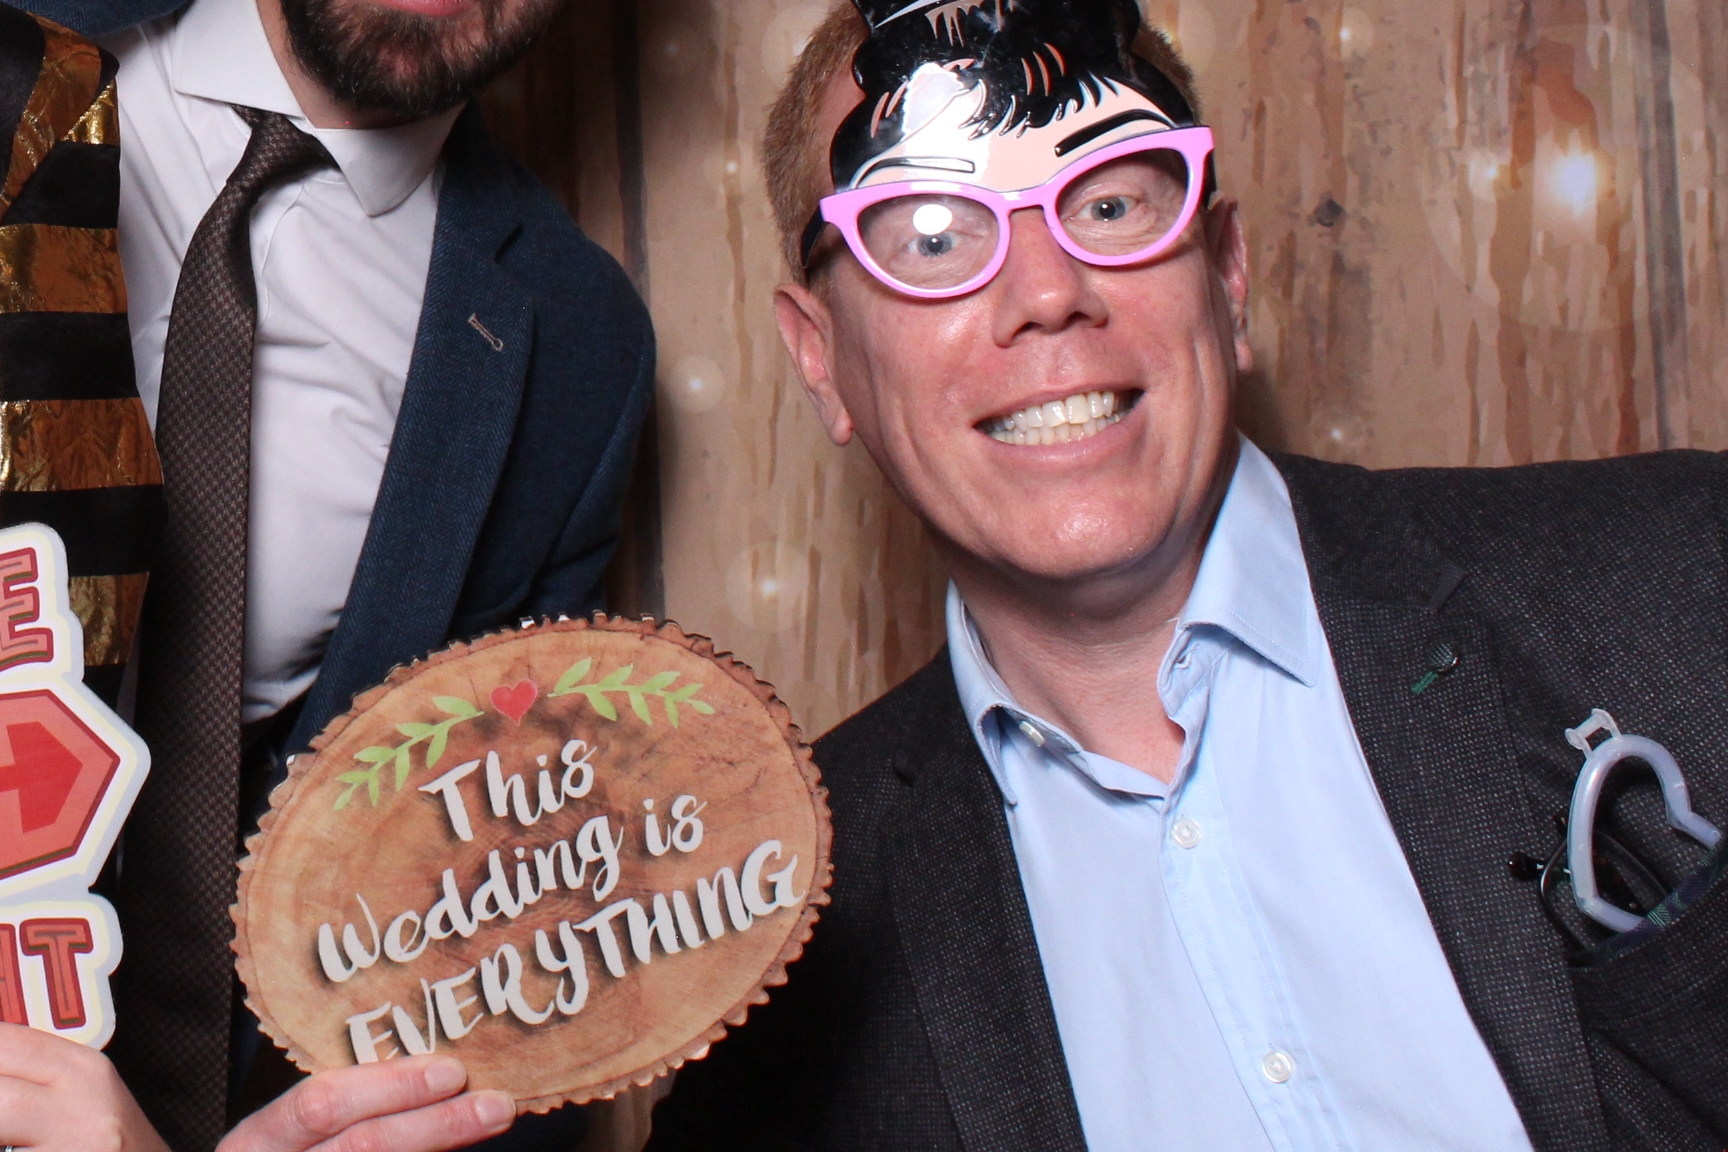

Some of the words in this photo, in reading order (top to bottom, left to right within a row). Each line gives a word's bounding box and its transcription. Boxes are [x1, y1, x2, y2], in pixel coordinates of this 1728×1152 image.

[418, 739, 597, 842] This
[318, 815, 624, 983] Wedding
[645, 795, 708, 855] is
[345, 839, 806, 1064] EVERYTHING
